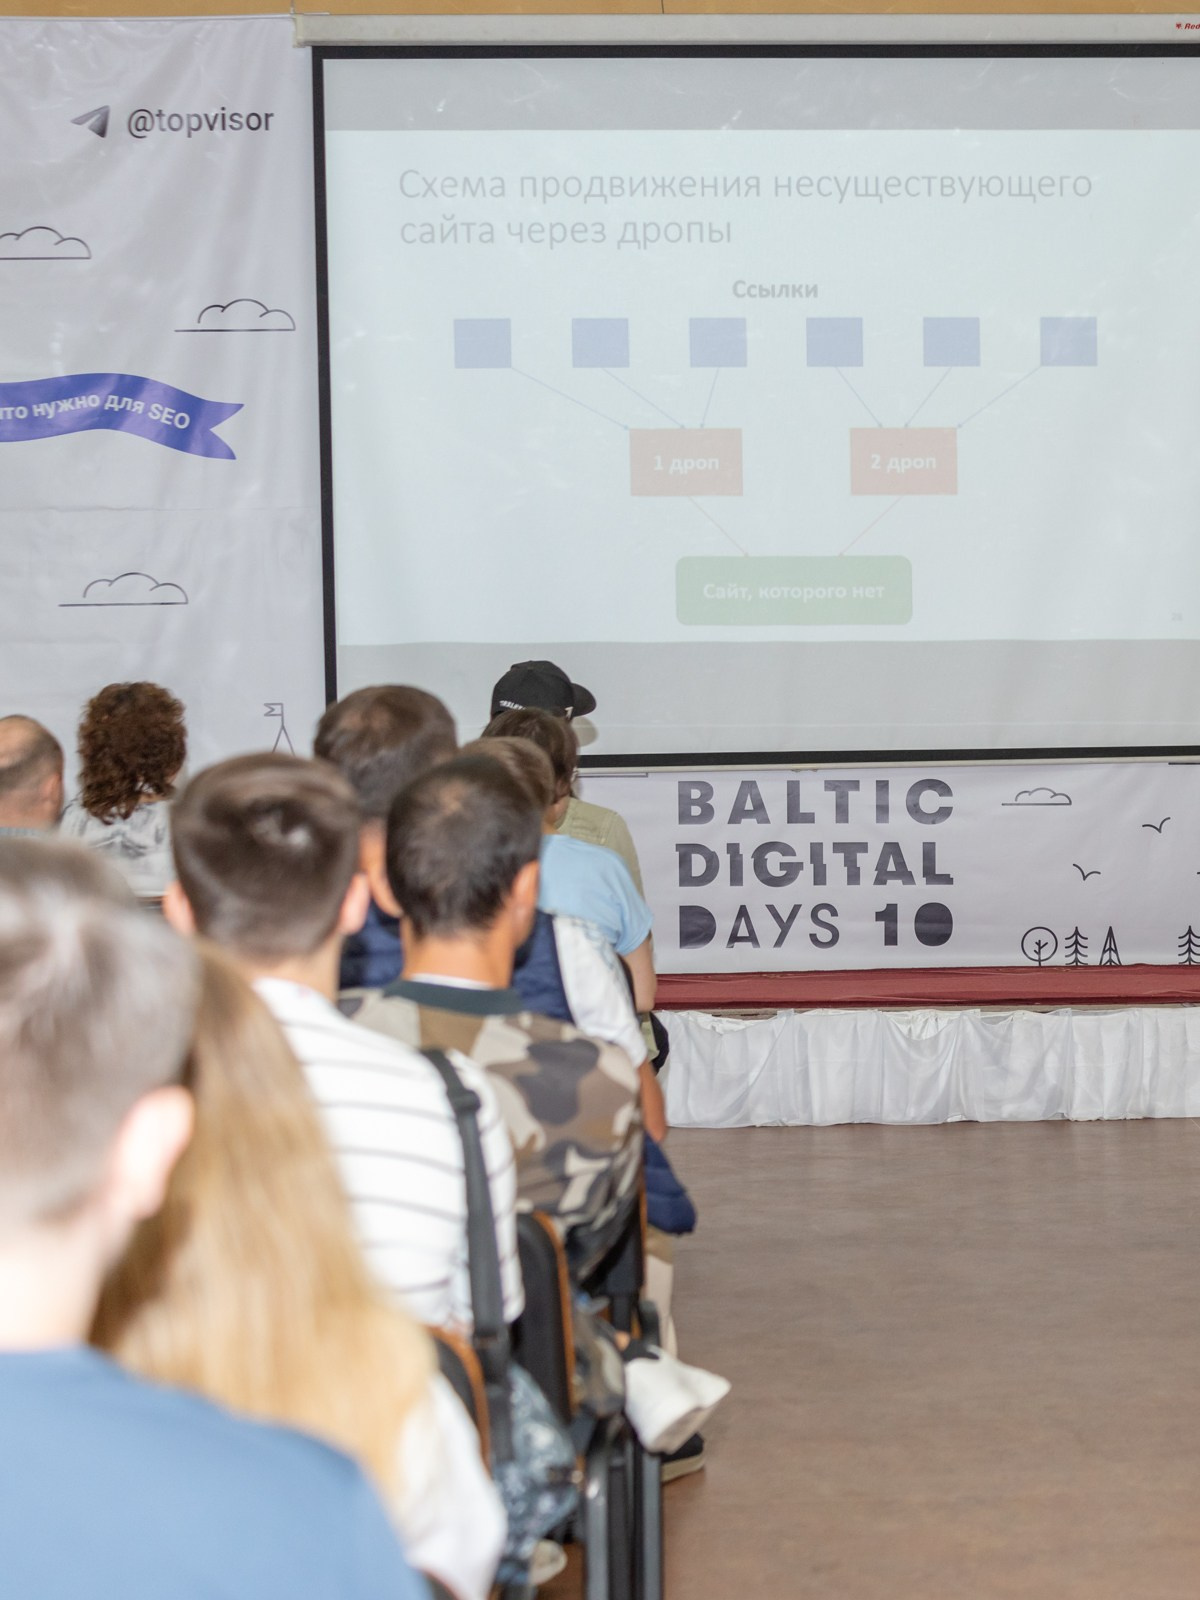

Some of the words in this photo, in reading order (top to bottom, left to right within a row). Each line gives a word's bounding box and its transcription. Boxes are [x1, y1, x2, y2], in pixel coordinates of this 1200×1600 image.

[127, 106, 274, 139] @topvisor
[399, 169, 506, 199] Схема
[520, 175, 761, 204] продвижения
[774, 174, 1092, 204] несуществующего
[400, 213, 495, 244] сайта
[507, 221, 606, 250] через
[617, 220, 731, 250] дропы
[732, 279, 819, 299] Ссылки
[33, 394, 100, 419] нужно
[104, 394, 145, 414] для
[148, 403, 190, 429] SEO
[653, 455, 664, 471] 1
[669, 457, 720, 475] дроп
[870, 454, 881, 469] 2
[886, 457, 937, 474] дроп
[703, 583, 752, 600] Сайт,
[759, 584, 847, 602] которого
[852, 584, 885, 599] нет
[678, 778, 954, 825] BALTIC
[675, 841, 954, 888] DIGITAL
[679, 902, 840, 950] DAYS
[875, 902, 954, 947] 10
